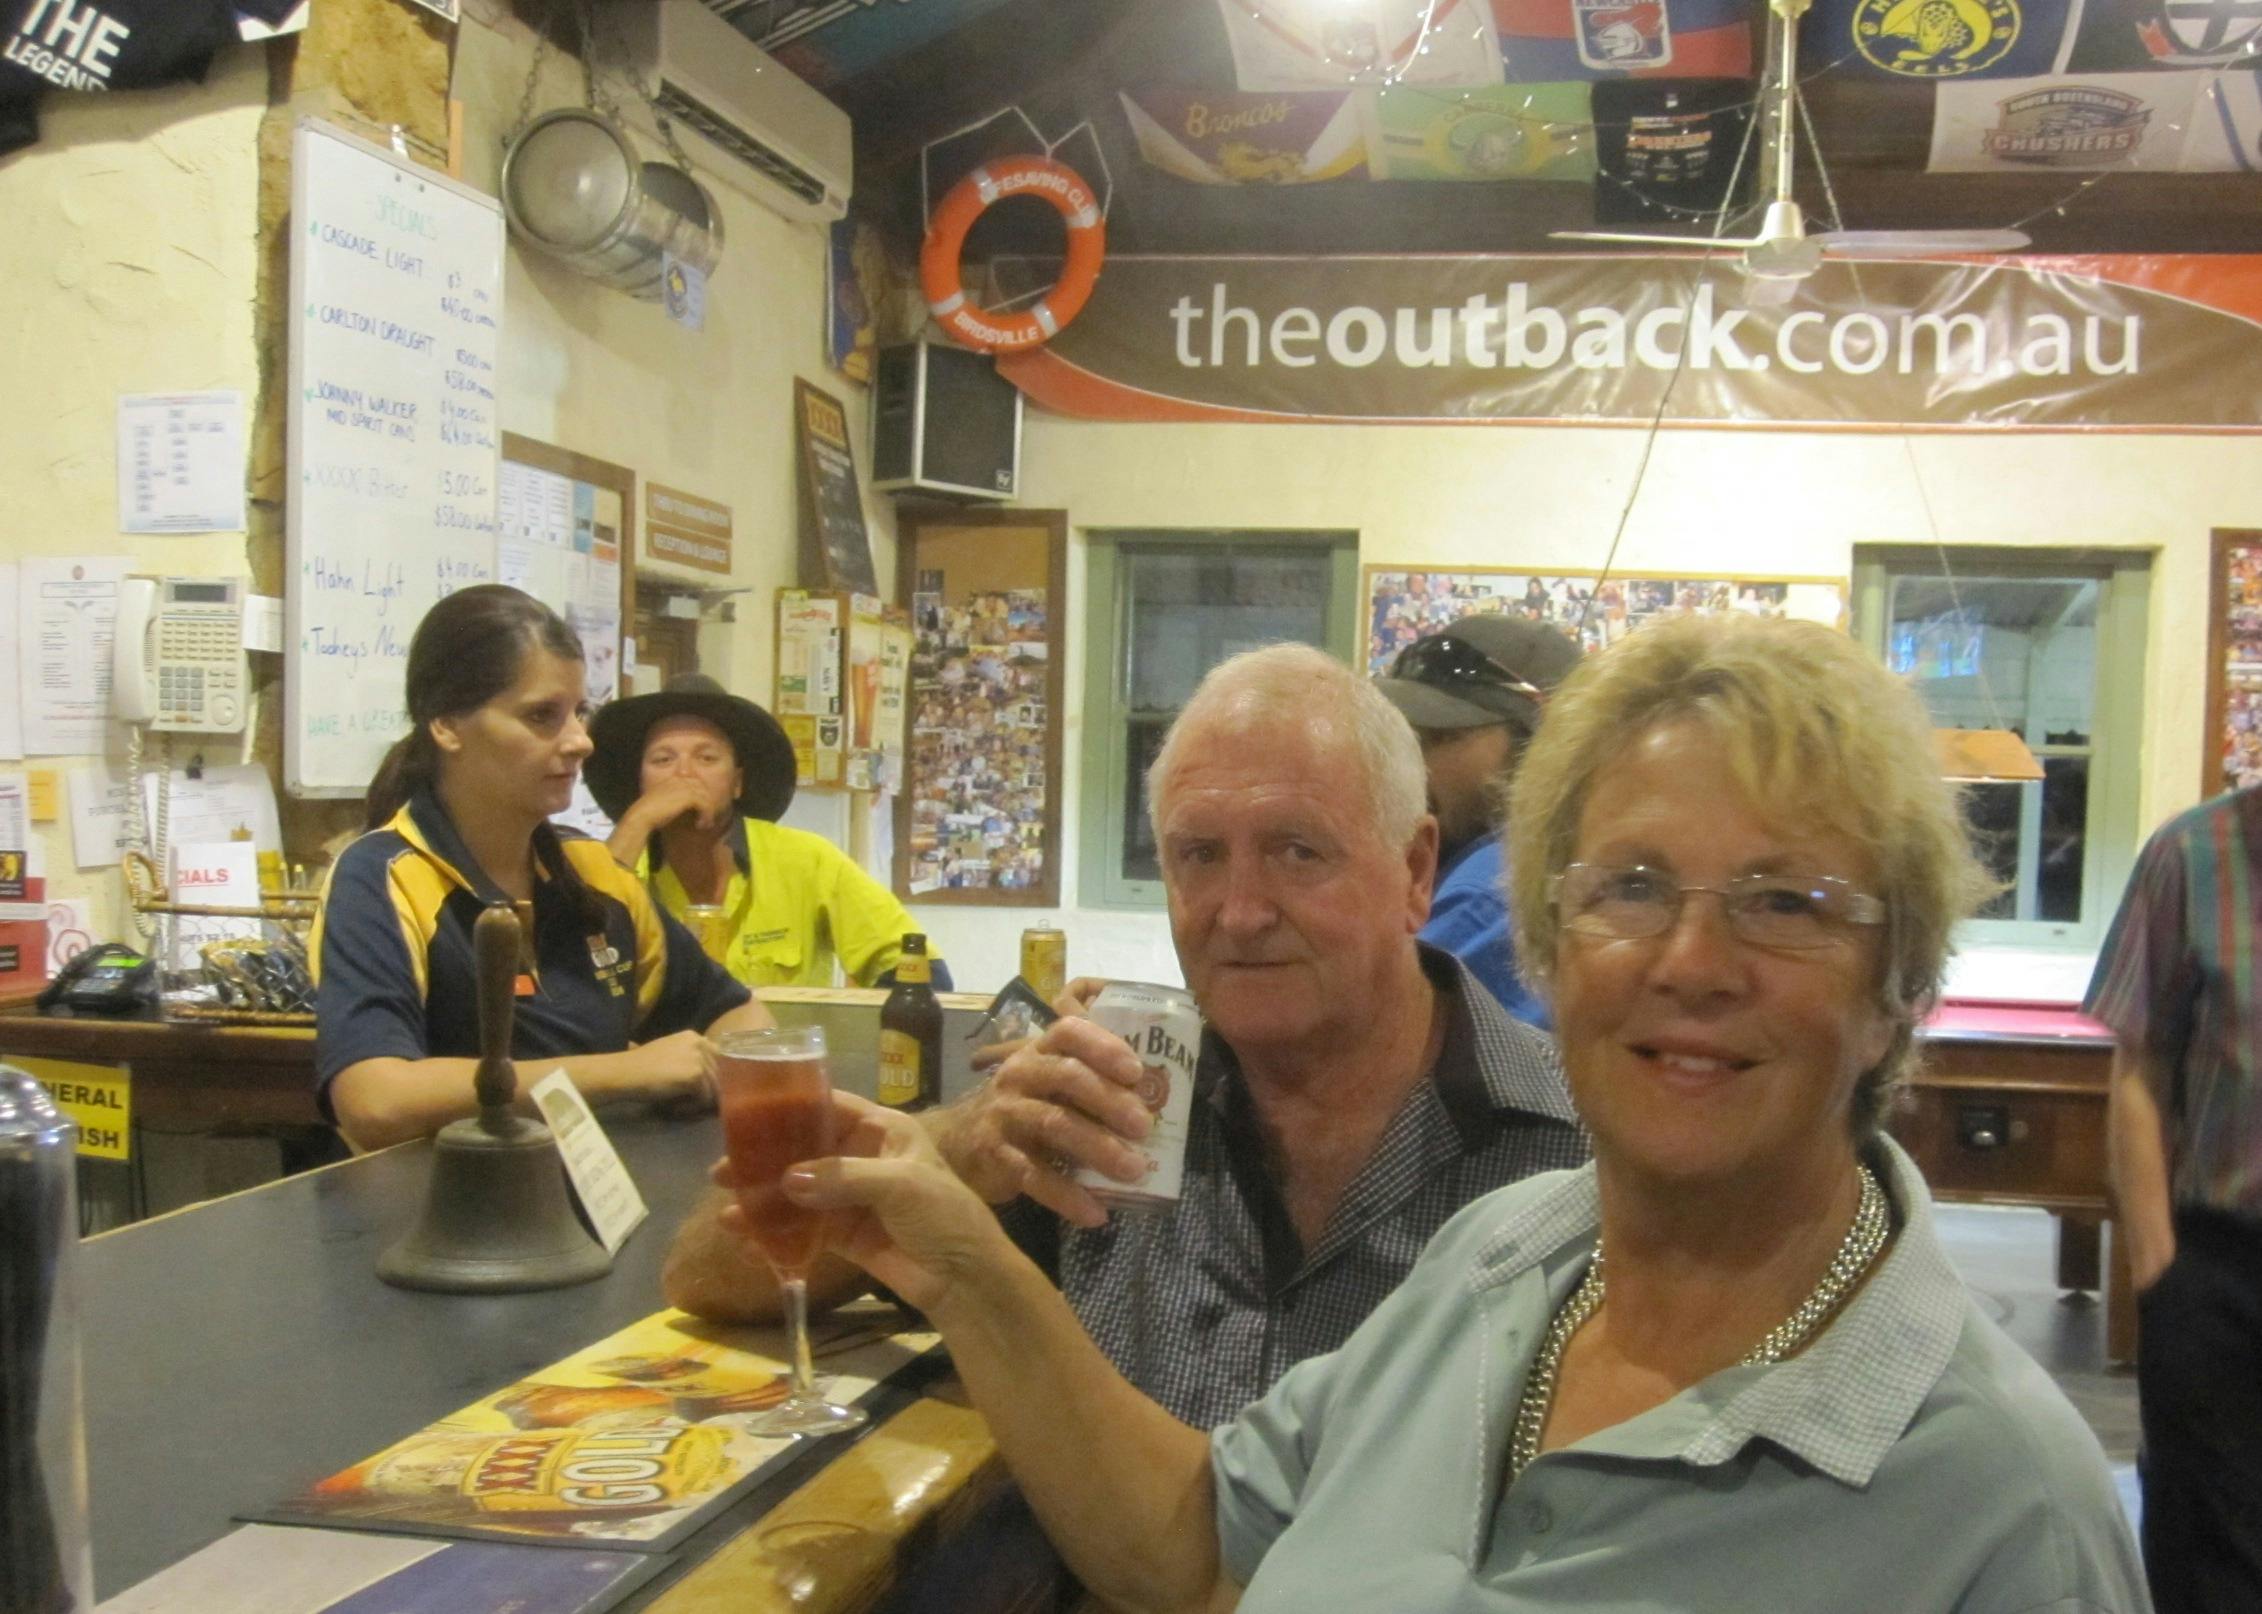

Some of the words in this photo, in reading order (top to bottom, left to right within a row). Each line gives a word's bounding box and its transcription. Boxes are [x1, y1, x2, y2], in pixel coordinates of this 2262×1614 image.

[1184, 101, 1298, 138] Broncos
[321, 223, 379, 260] CASCADE
[386, 247, 424, 278] LIGHT
[320, 304, 377, 336] CARLTON
[380, 319, 437, 358] DRAUGHT
[953, 311, 1039, 345] BIRDSVILLE
[1170, 281, 2140, 375] theoutback.com.au
[314, 556, 354, 591] Hahn
[363, 557, 405, 617] Light
[176, 867, 229, 884] CIALS
[77, 1126, 119, 1149] ISH
[474, 1437, 568, 1493] XXXX
[559, 1427, 684, 1507] GOLD
